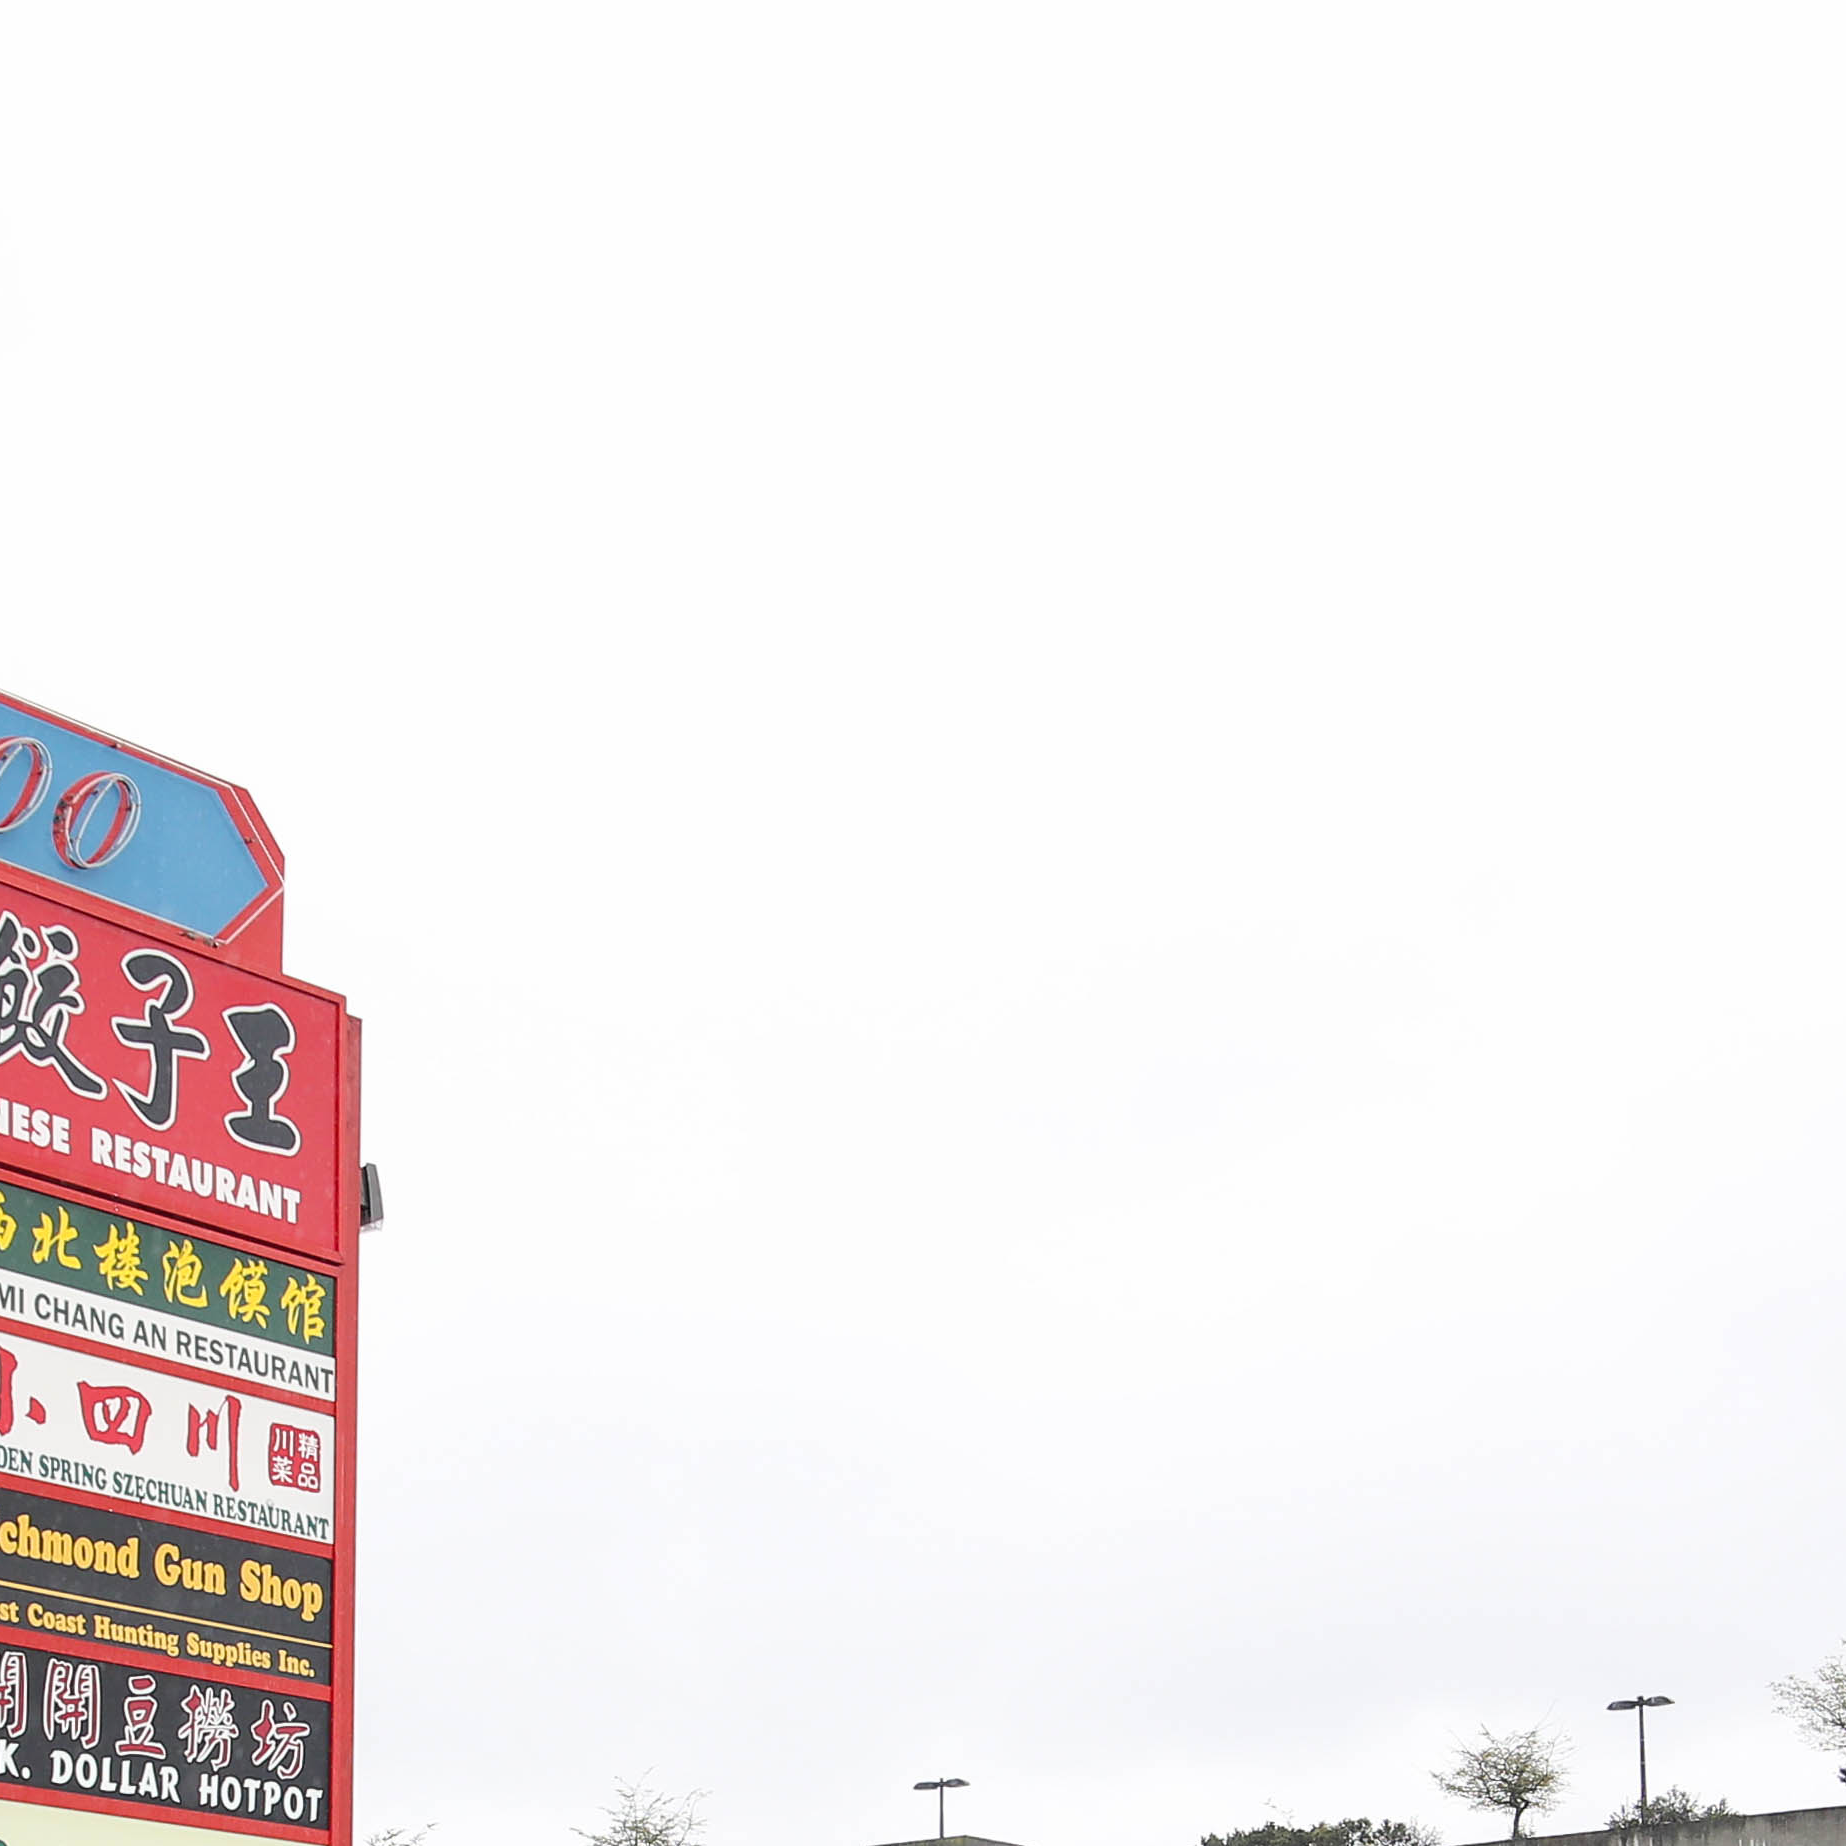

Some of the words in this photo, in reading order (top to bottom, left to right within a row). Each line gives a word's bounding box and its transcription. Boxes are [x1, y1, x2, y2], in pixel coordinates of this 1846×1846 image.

[91, 1134, 300, 1225] RESTAURANT
[35, 1293, 124, 1339] CHANG
[134, 1322, 166, 1351] AN
[177, 1331, 333, 1394] RESTAURANT
[272, 1428, 295, 1483] 川菜
[39, 1456, 106, 1490] SPRING
[113, 1473, 207, 1512] SZECHUAN
[213, 1494, 329, 1539] RESTAURANT
[154, 1543, 226, 1595] Gun
[240, 1559, 323, 1621] Shop
[27, 1603, 87, 1635] Coast
[93, 1614, 180, 1657] Hunting
[186, 1632, 270, 1669] Supplies
[278, 1651, 315, 1677] Inc.
[50, 1750, 180, 1803] DOLLAR
[199, 1773, 324, 1822] HOTPOT
